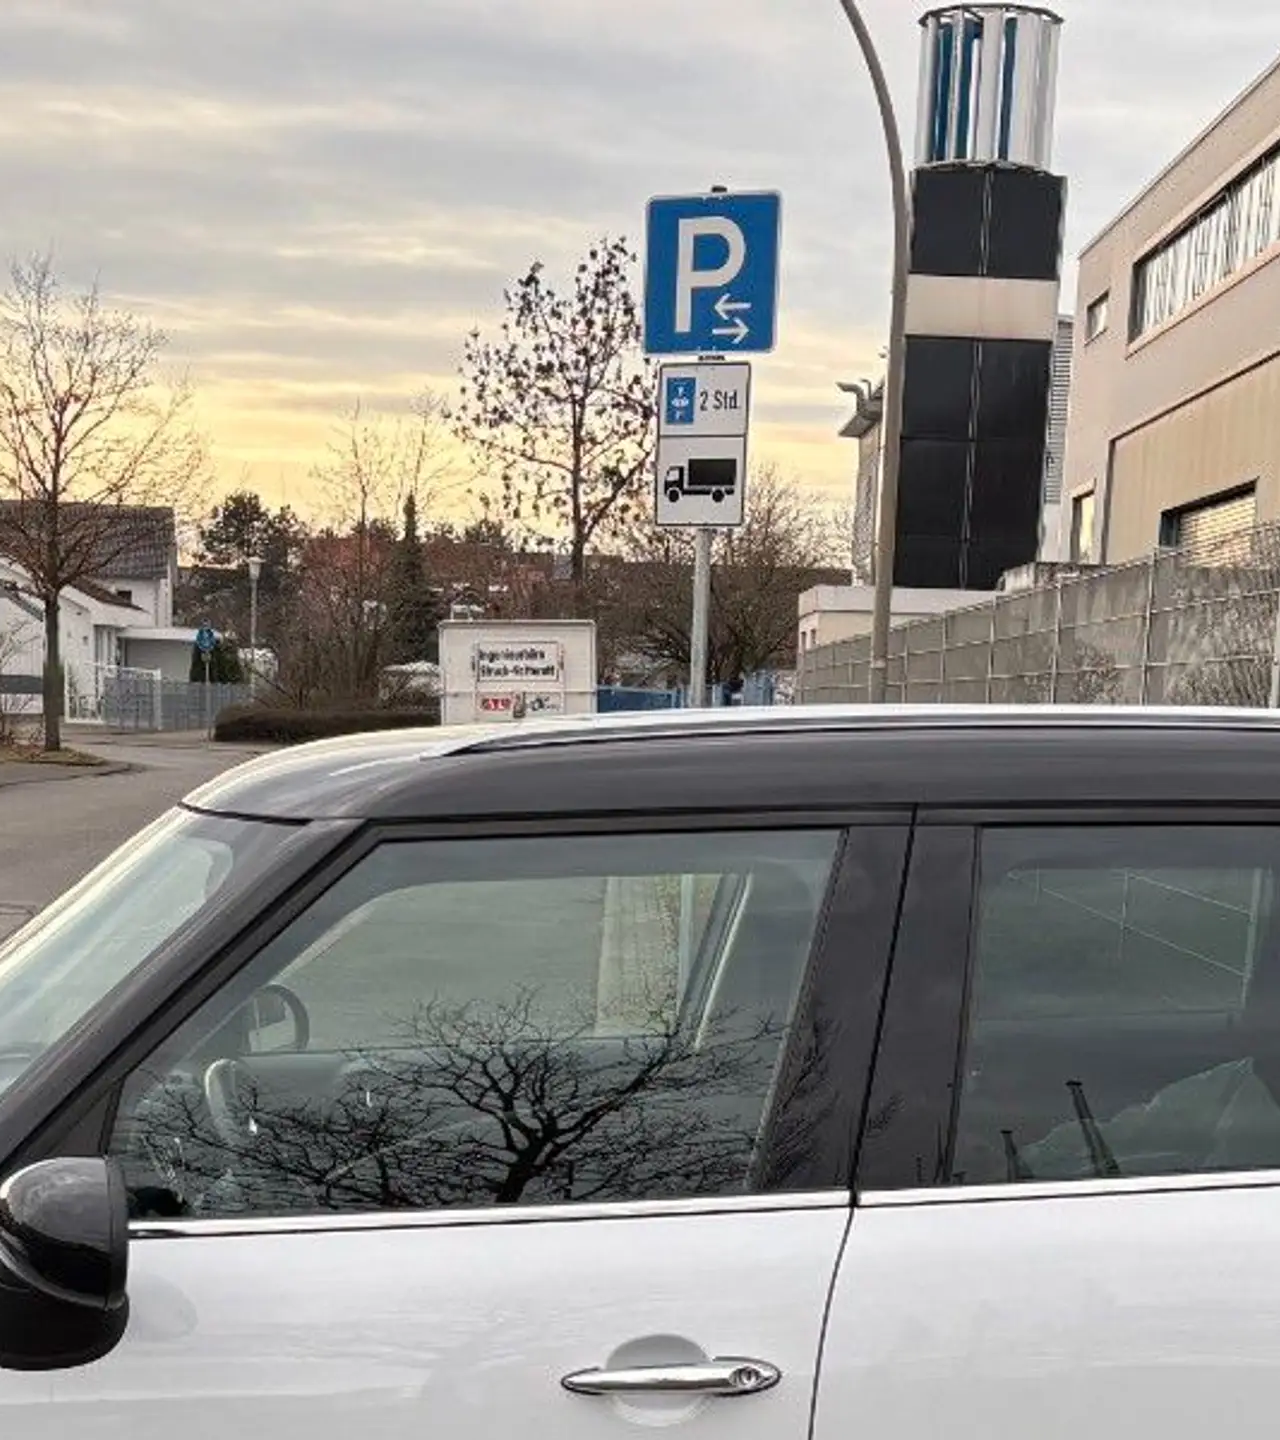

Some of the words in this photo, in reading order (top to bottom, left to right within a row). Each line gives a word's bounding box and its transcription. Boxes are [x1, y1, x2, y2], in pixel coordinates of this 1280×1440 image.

[675, 216, 746, 333] P
[700, 390, 708, 411] 2
[713, 389, 741, 410] Std.
